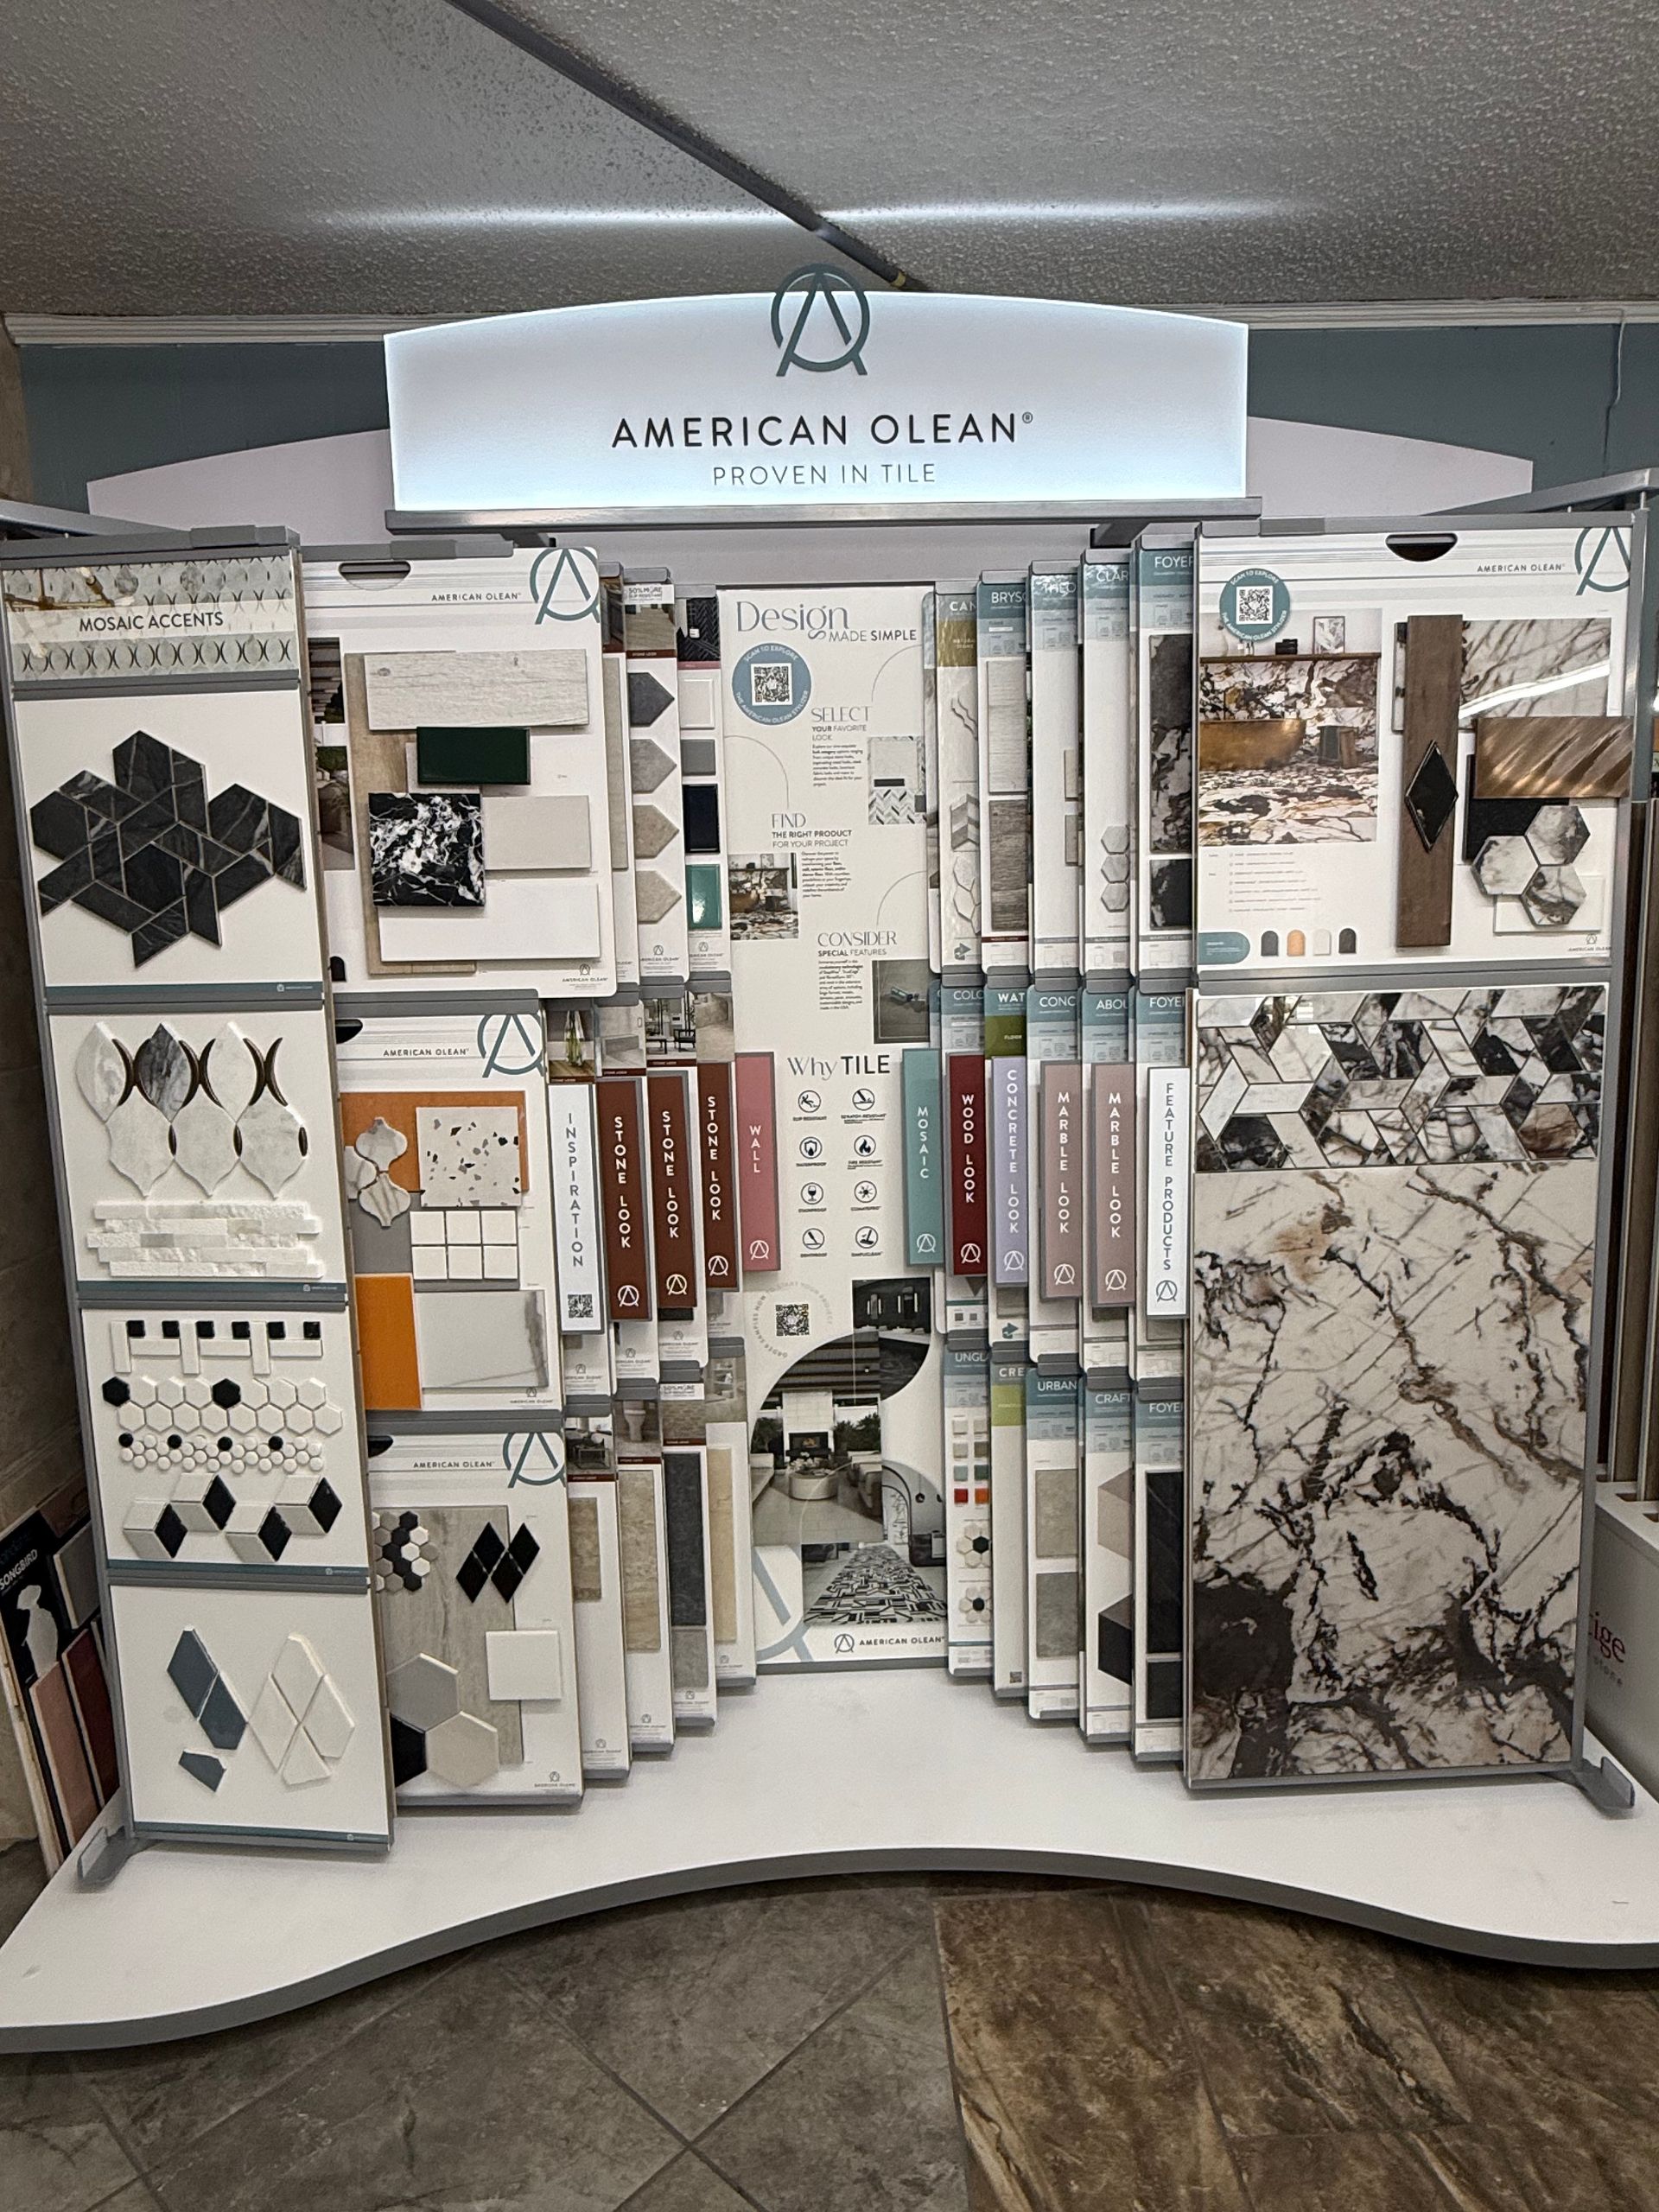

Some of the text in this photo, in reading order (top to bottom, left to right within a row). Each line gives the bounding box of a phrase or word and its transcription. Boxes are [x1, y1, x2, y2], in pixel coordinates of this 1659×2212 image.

[611, 414, 846, 448] AMERICAN
[713, 463, 935, 486] PROVEN IN TILE
[1477, 563, 1527, 573] AMERICAN
[431, 593, 482, 602] AMERICAN
[79, 612, 224, 632] MOSAIC ACCENTS
[736, 601, 849, 640] Design
[829, 629, 917, 642] MADE SIMPLE
[810, 705, 873, 723] SELECT
[772, 812, 806, 829] FIND
[772, 840, 789, 849] FOR
[790, 839, 812, 848] YOUR
[817, 930, 898, 948] CONSIDER
[817, 948, 887, 957] SPECIAL FEATURES
[1039, 995, 1077, 1007] CONC
[1149, 995, 1185, 1008] FOYE
[383, 1048, 432, 1057] AMERICAN
[787, 1054, 891, 1081] Why TILE
[749, 1124, 762, 1173] WALL
[916, 1106, 930, 1179] MOSAIC
[961, 1094, 976, 1204] WOOD LOOK
[1007, 1069, 1020, 1234] CONCRETE LOOK
[707, 1096, 721, 1221] STONE LOOK
[1057, 1092, 1070, 1233] MARBLE LOOK
[1108, 1092, 1122, 1238] MARBLE LOOK
[613, 1116, 631, 1249] STONE LOOK
[662, 1110, 679, 1238] STONE LOOK
[1162, 1083, 1175, 1271] FEATURE PRODUCTS
[565, 1112, 583, 1267] INSPIRATION
[955, 1351, 990, 1363] UNGL
[1037, 1381, 1077, 1391] URBAN
[1149, 1402, 1183, 1414] FOYE
[859, 1637, 907, 1646] AMERICAN
